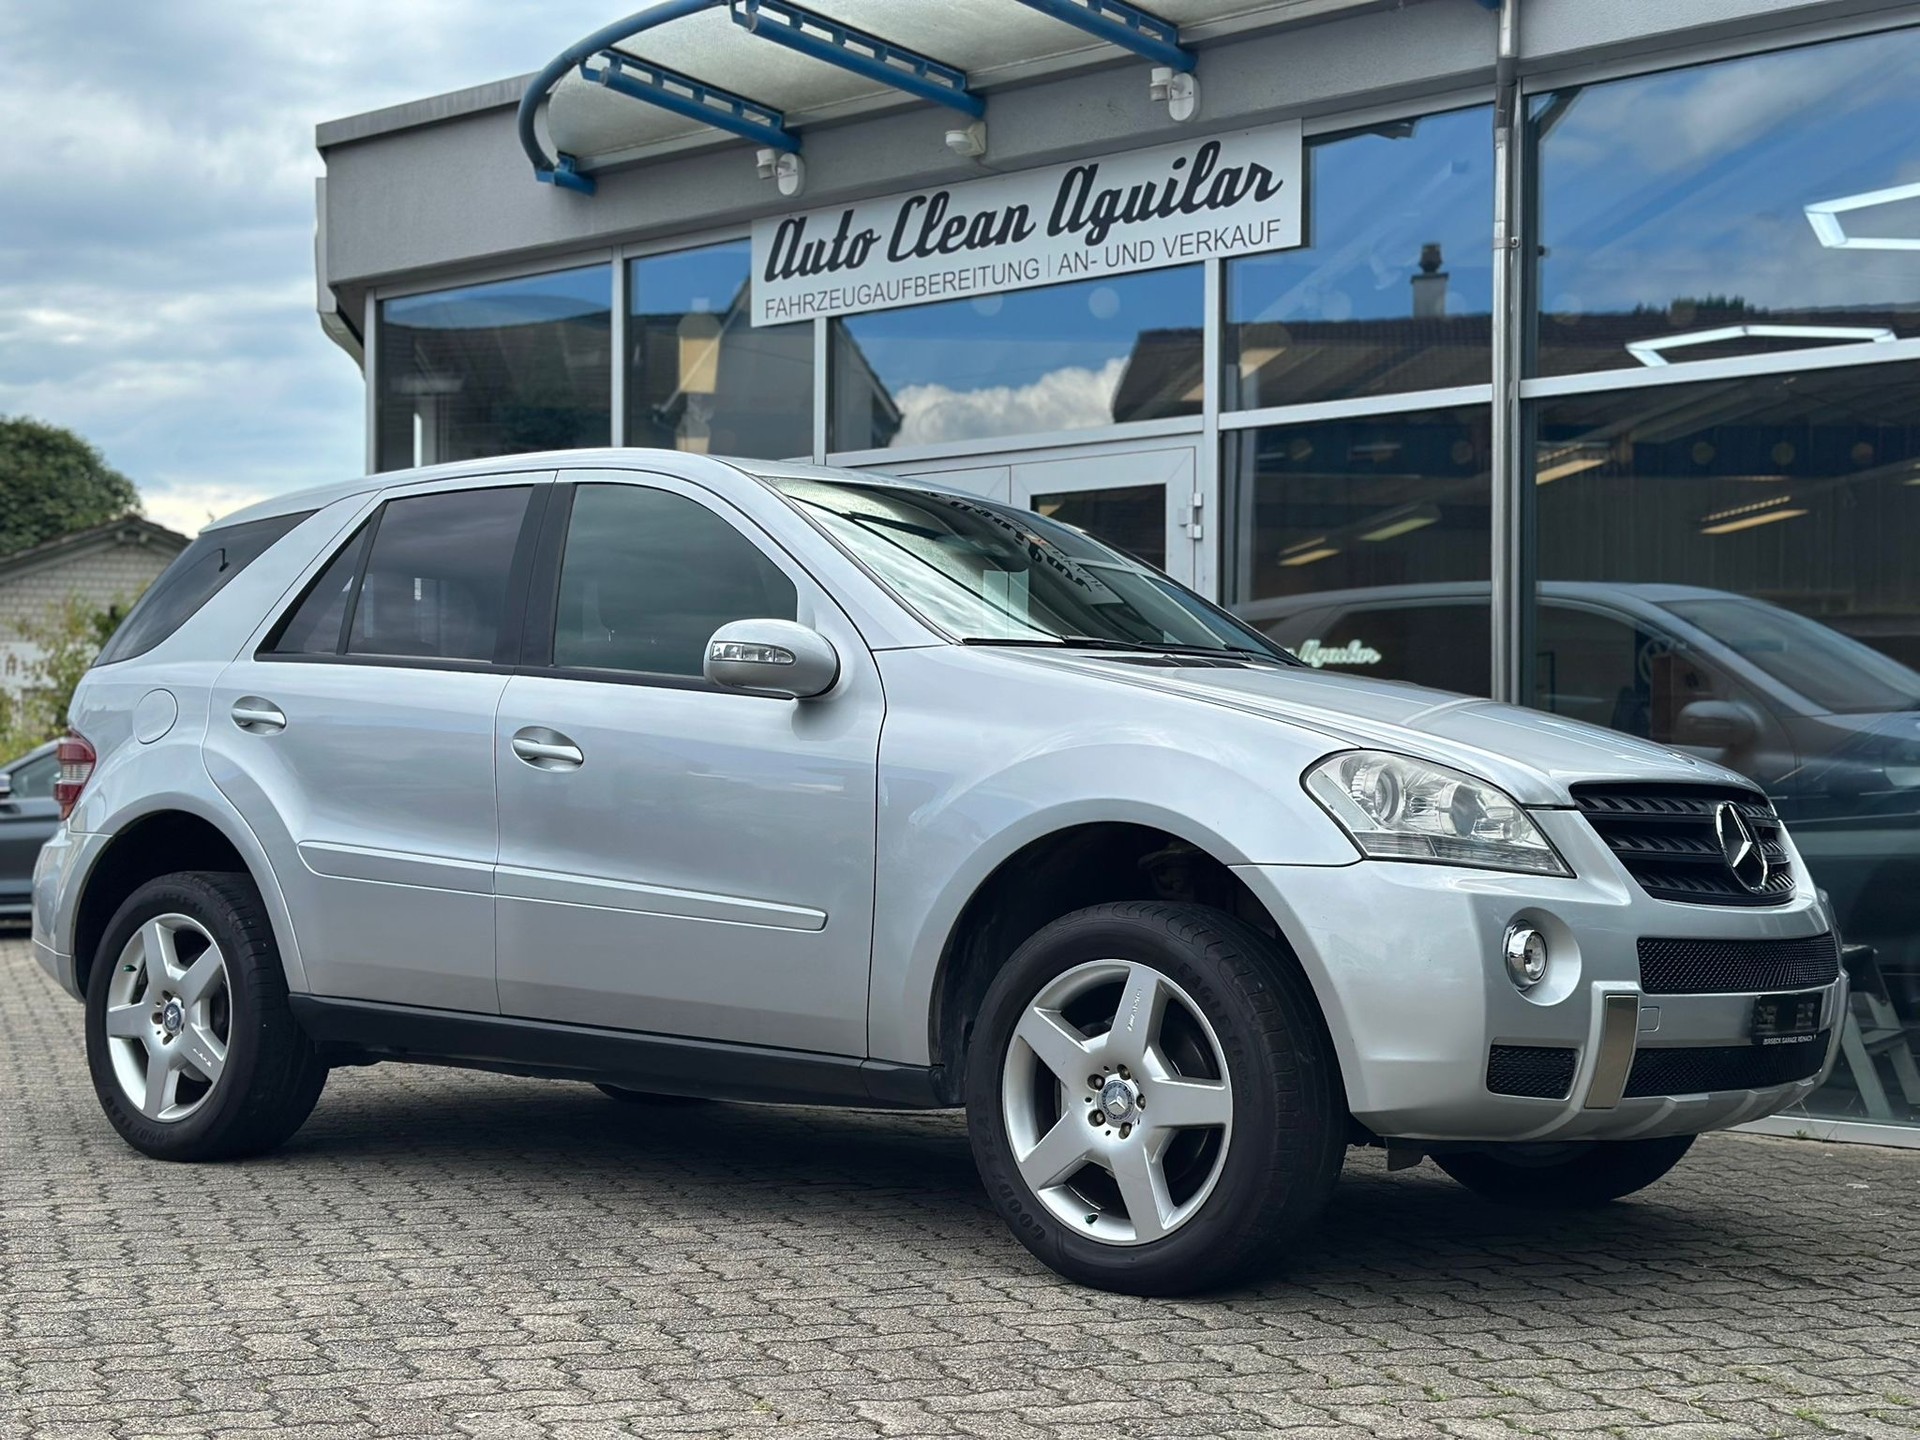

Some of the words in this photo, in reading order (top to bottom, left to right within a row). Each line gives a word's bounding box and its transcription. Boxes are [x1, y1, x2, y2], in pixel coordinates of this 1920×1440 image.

[764, 208, 882, 283] Auto
[886, 190, 1037, 263] Clean
[1047, 140, 1284, 246] Aguilar
[765, 257, 1040, 320] FAHRZEUGAUFBEREITUNG
[1058, 250, 1098, 276] AN-
[1105, 239, 1156, 268] UND
[1163, 219, 1281, 260] VERKAUF
